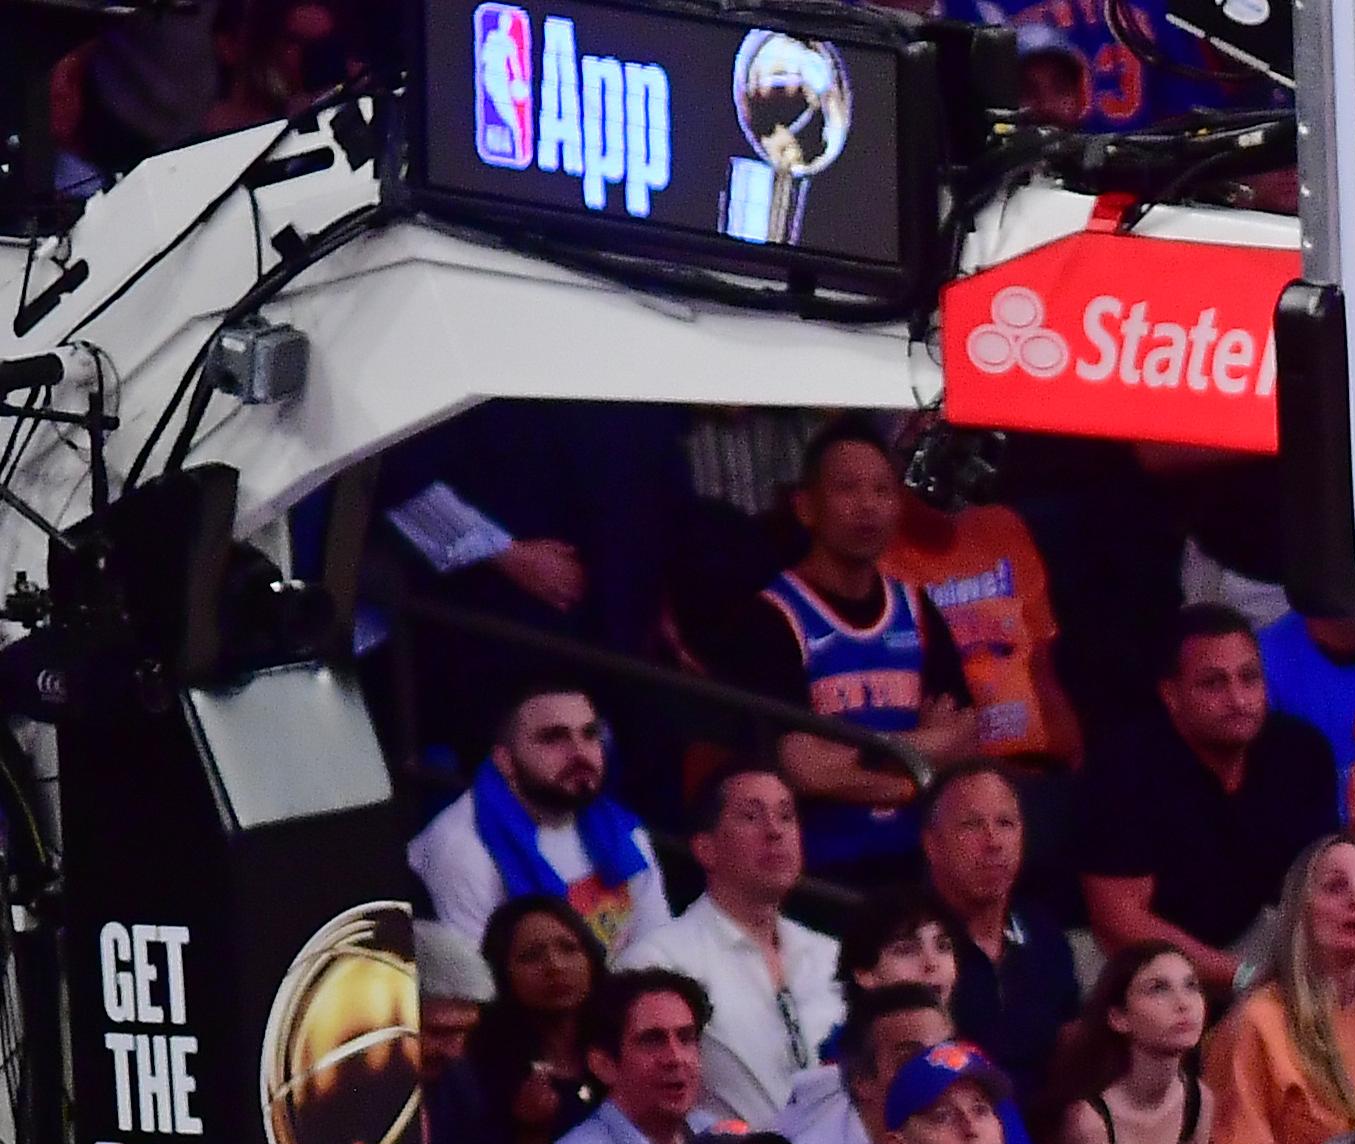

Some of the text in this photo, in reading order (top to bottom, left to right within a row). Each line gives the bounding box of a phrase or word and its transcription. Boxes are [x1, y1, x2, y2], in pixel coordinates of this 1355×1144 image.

[537, 15, 670, 217] App
[1075, 295, 1255, 395] State
[100, 921, 190, 1025] GET
[104, 1033, 203, 1135] THE
